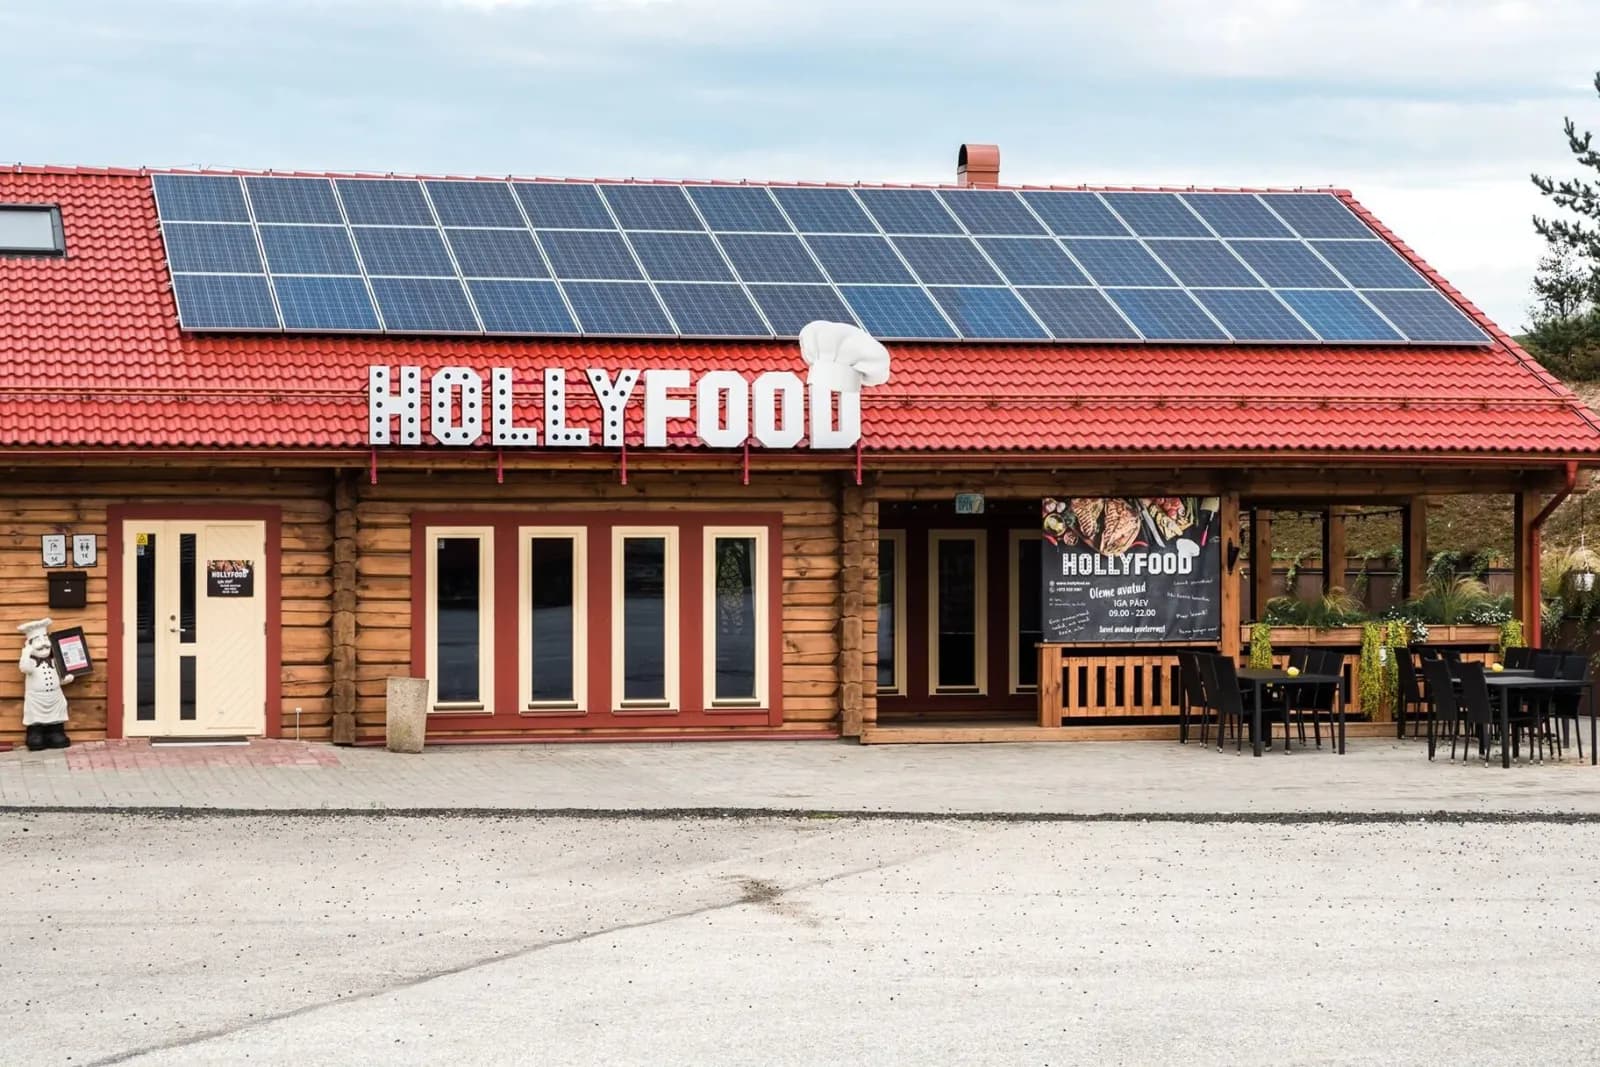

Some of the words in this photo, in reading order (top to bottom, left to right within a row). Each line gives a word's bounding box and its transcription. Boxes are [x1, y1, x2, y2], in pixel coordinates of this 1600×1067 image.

[369, 365, 861, 449] HOLLYFOOD
[1062, 552, 1193, 576] HOLLYFOOD
[1089, 587, 1115, 599] Oleme
[1117, 581, 1147, 596] avatud
[1113, 599, 1128, 607] IGA
[1108, 609, 1130, 617] 09.00
[1135, 608, 1156, 617] 22.00
